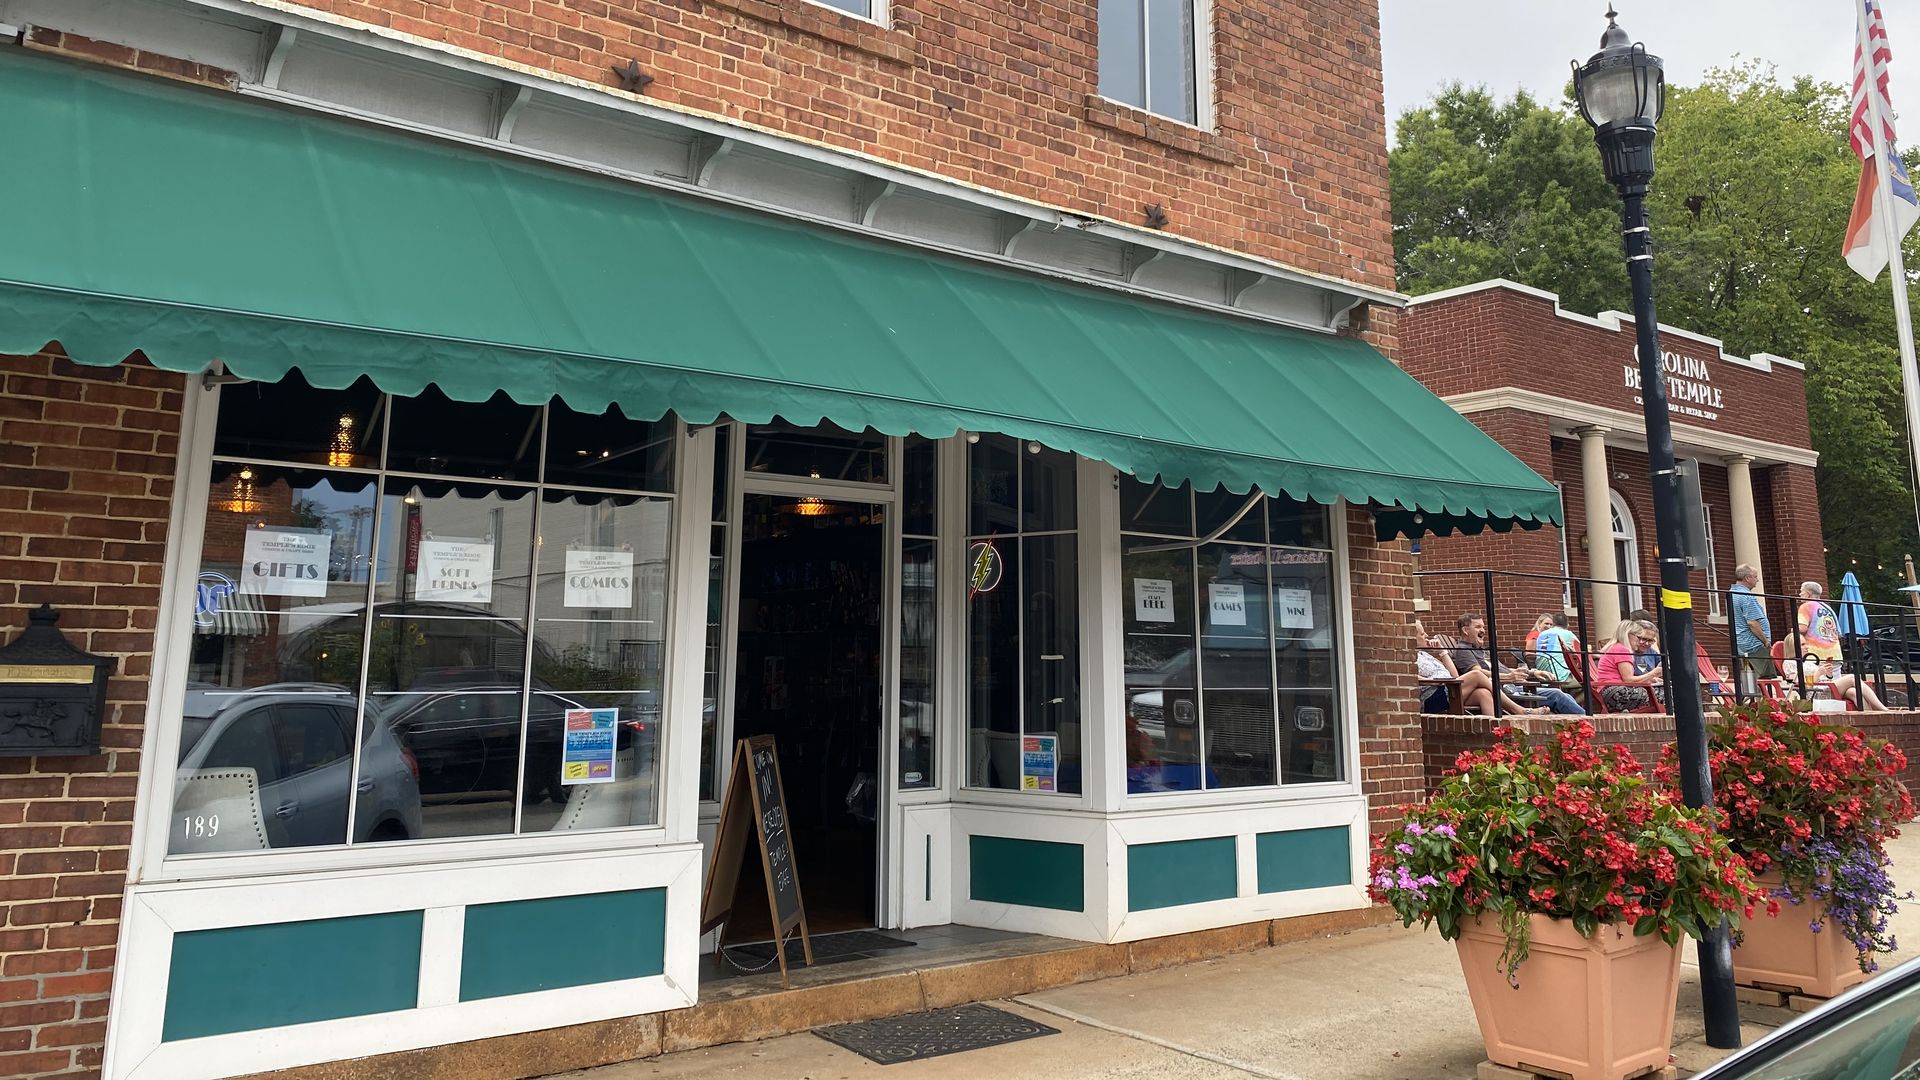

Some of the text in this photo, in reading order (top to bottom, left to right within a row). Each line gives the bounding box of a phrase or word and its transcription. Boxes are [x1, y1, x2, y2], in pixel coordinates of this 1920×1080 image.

[1633, 344, 1710, 381] OLINA
[1667, 376, 1724, 409] TEMPLE
[1667, 403, 1680, 413] BAR
[1679, 405, 1686, 414] &
[252, 560, 319, 580] GIFTS
[440, 567, 470, 578] SOFT
[431, 579, 478, 590] DRINKS
[569, 575, 629, 589] COMICS
[1143, 599, 1167, 609] BEER
[1213, 601, 1242, 612] GAMES
[1286, 606, 1306, 617] WINE
[183, 814, 220, 840] 189
